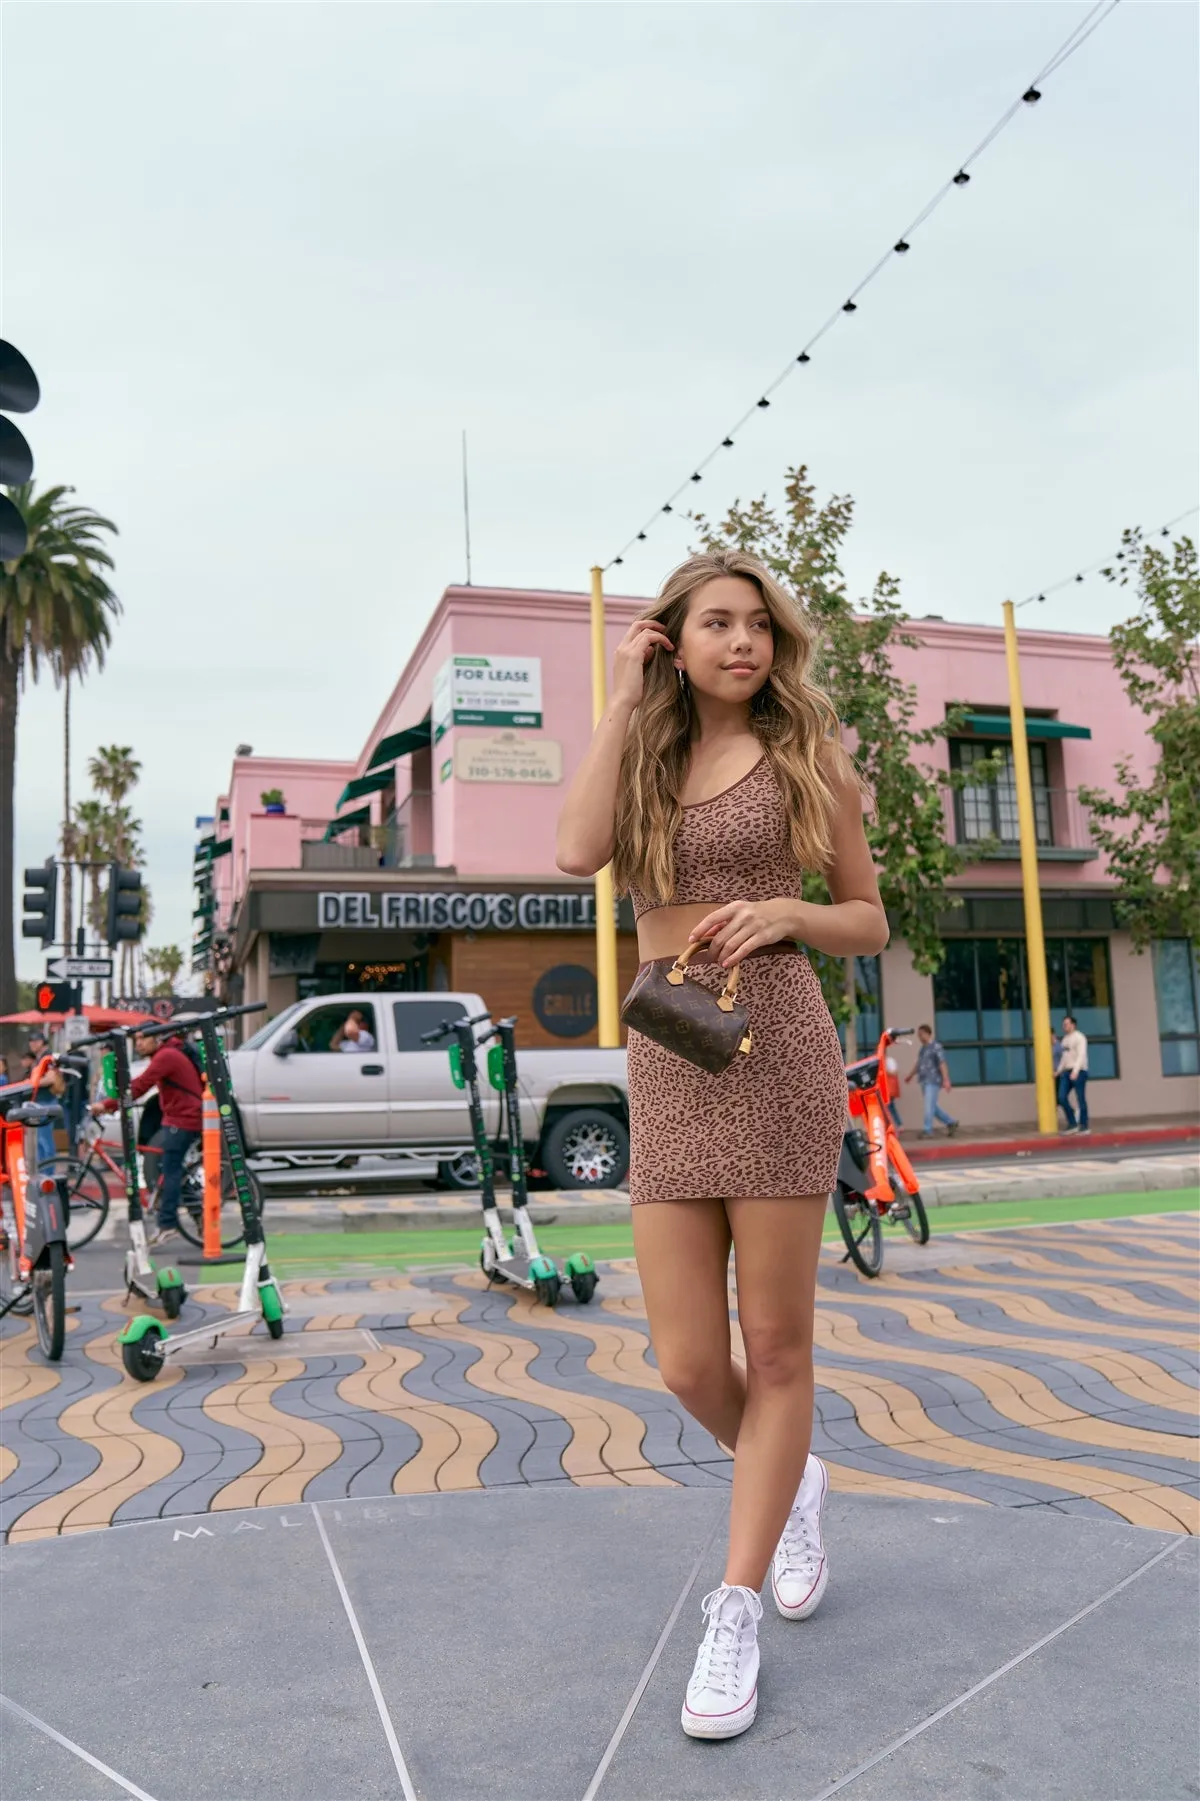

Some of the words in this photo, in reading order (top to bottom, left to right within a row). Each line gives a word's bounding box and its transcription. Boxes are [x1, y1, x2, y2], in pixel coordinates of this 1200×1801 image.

[455, 668, 484, 681] FOR
[488, 670, 529, 683] LEASE
[318, 892, 380, 929] DEL
[381, 892, 517, 930] FRISCO'S
[518, 893, 619, 930] GRILL
[88, 965, 107, 973] WAY
[543, 993, 592, 1017] GRILLE
